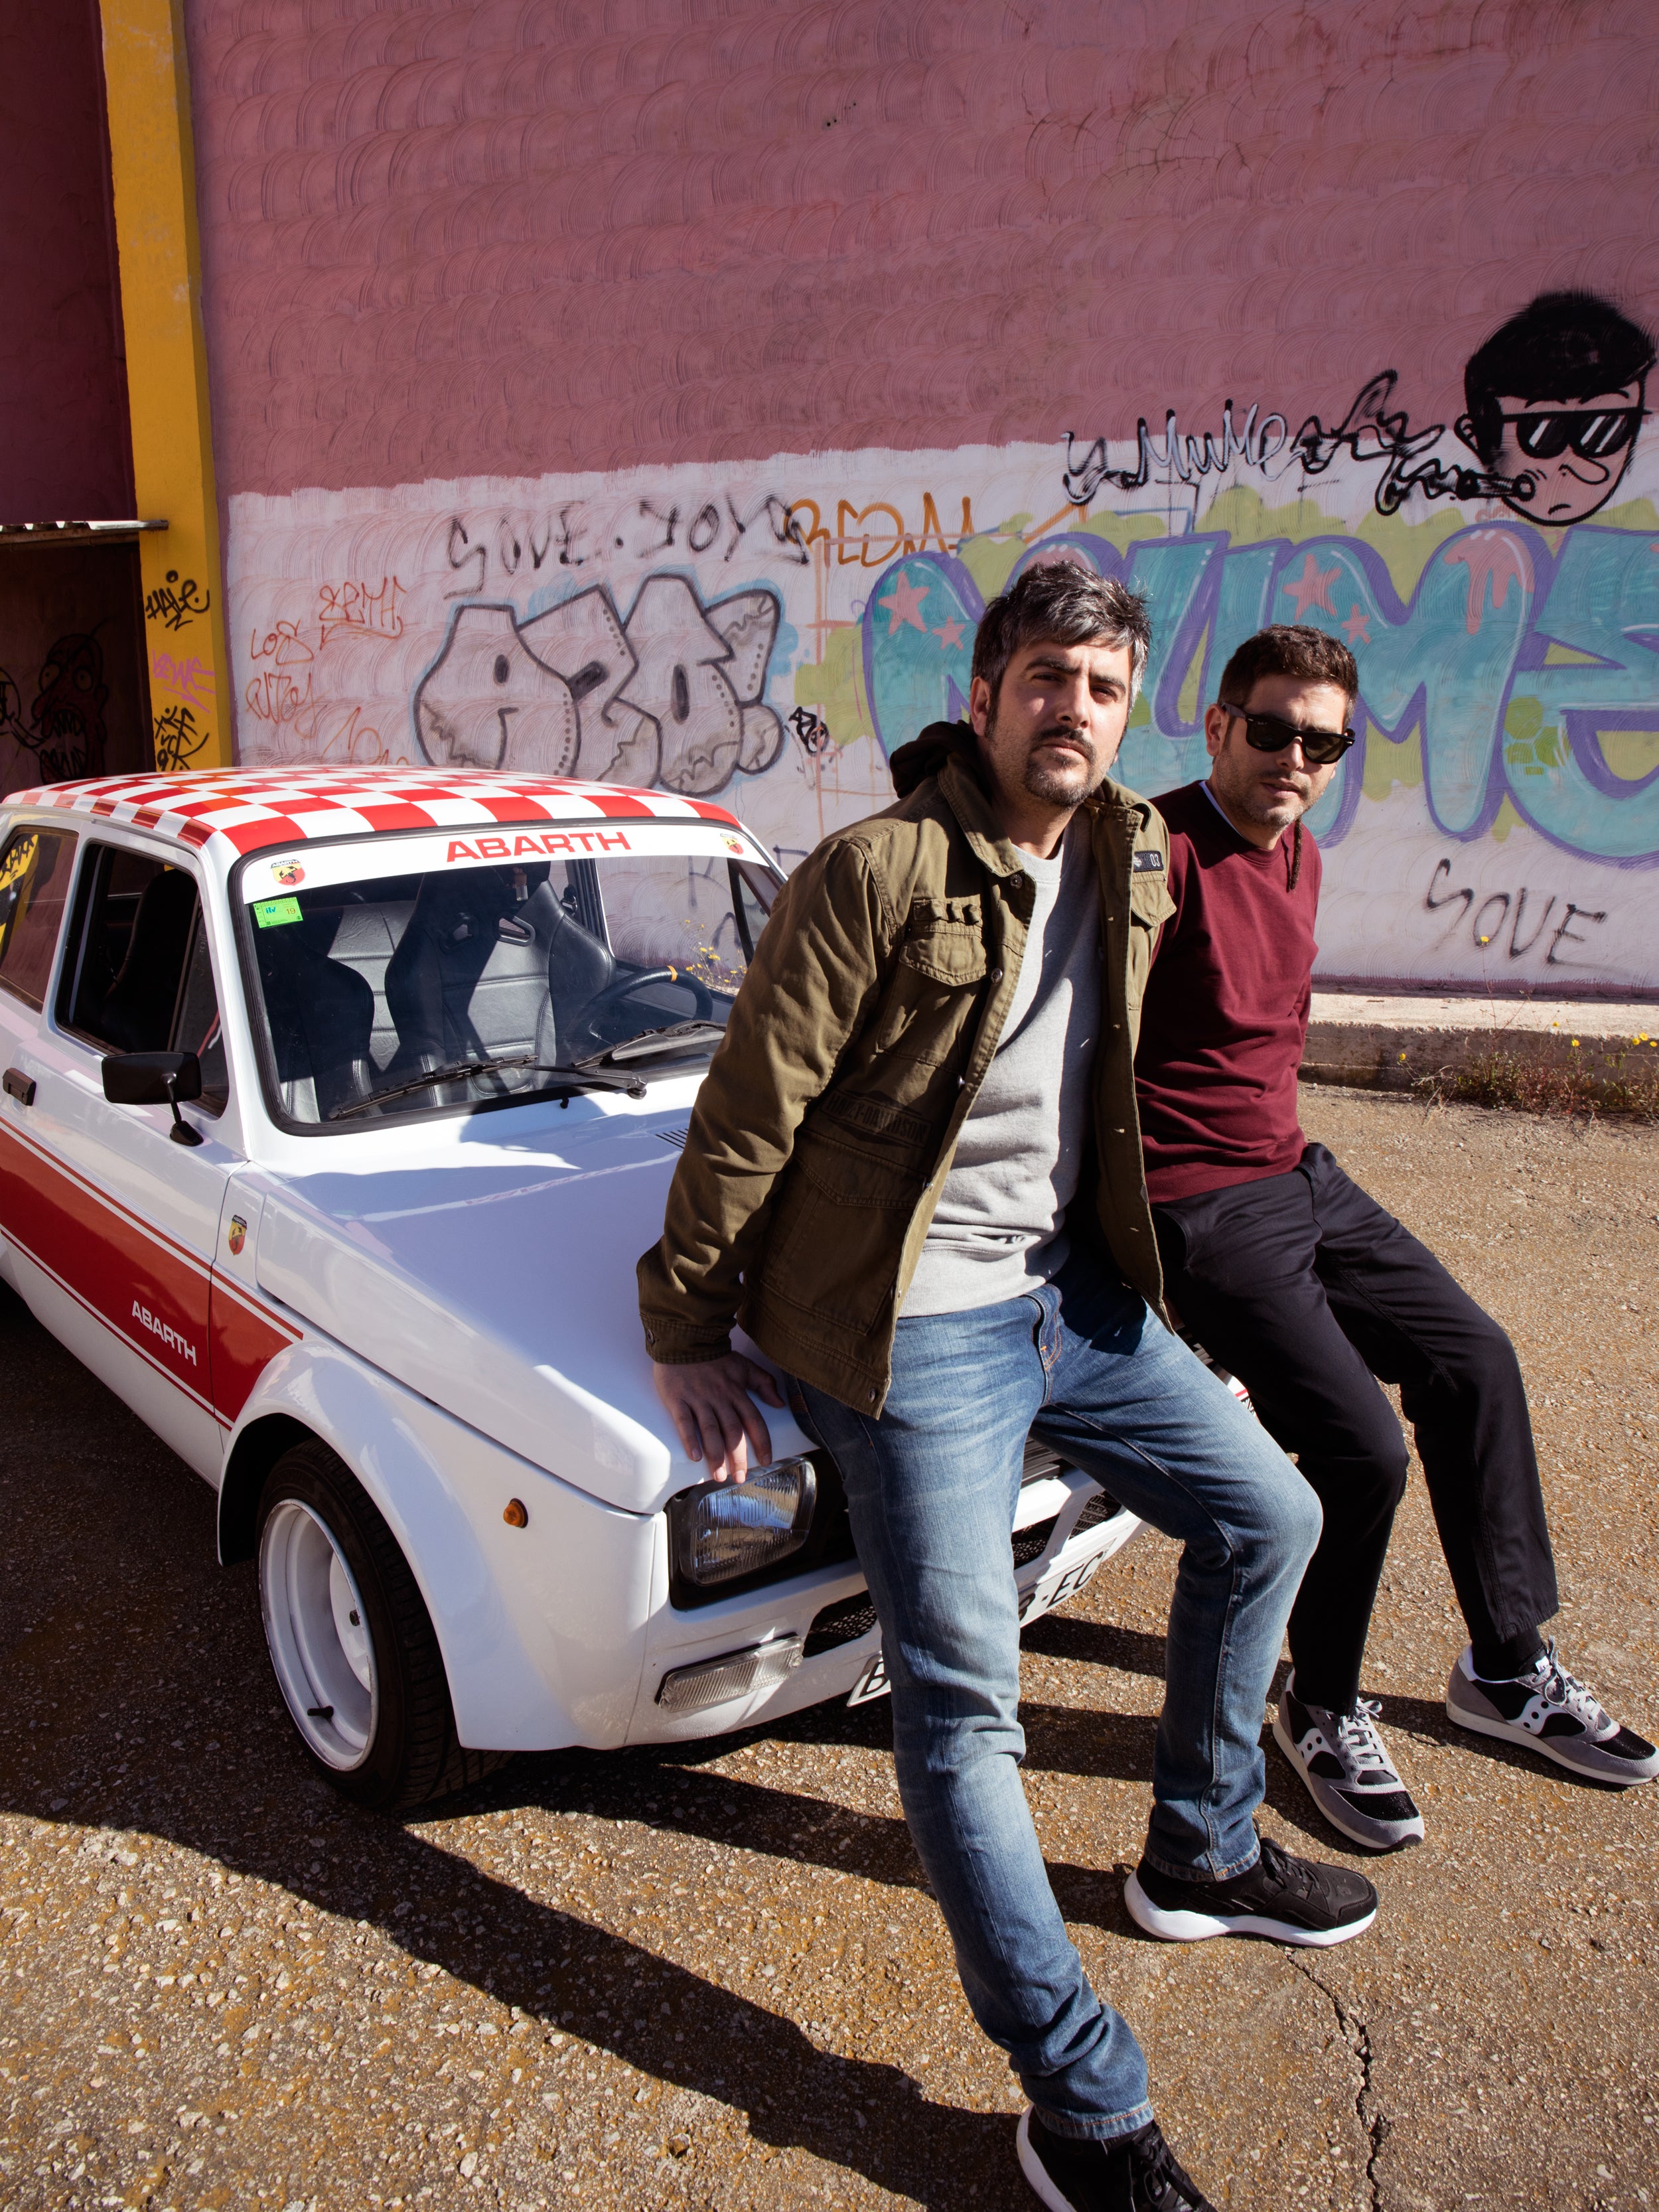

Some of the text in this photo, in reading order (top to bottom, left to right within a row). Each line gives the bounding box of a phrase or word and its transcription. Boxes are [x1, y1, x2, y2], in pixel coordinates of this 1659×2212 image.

[447, 831, 632, 863] ABARTH
[1425, 857, 1609, 966] SOVE
[131, 1299, 198, 1367] ABARTH
